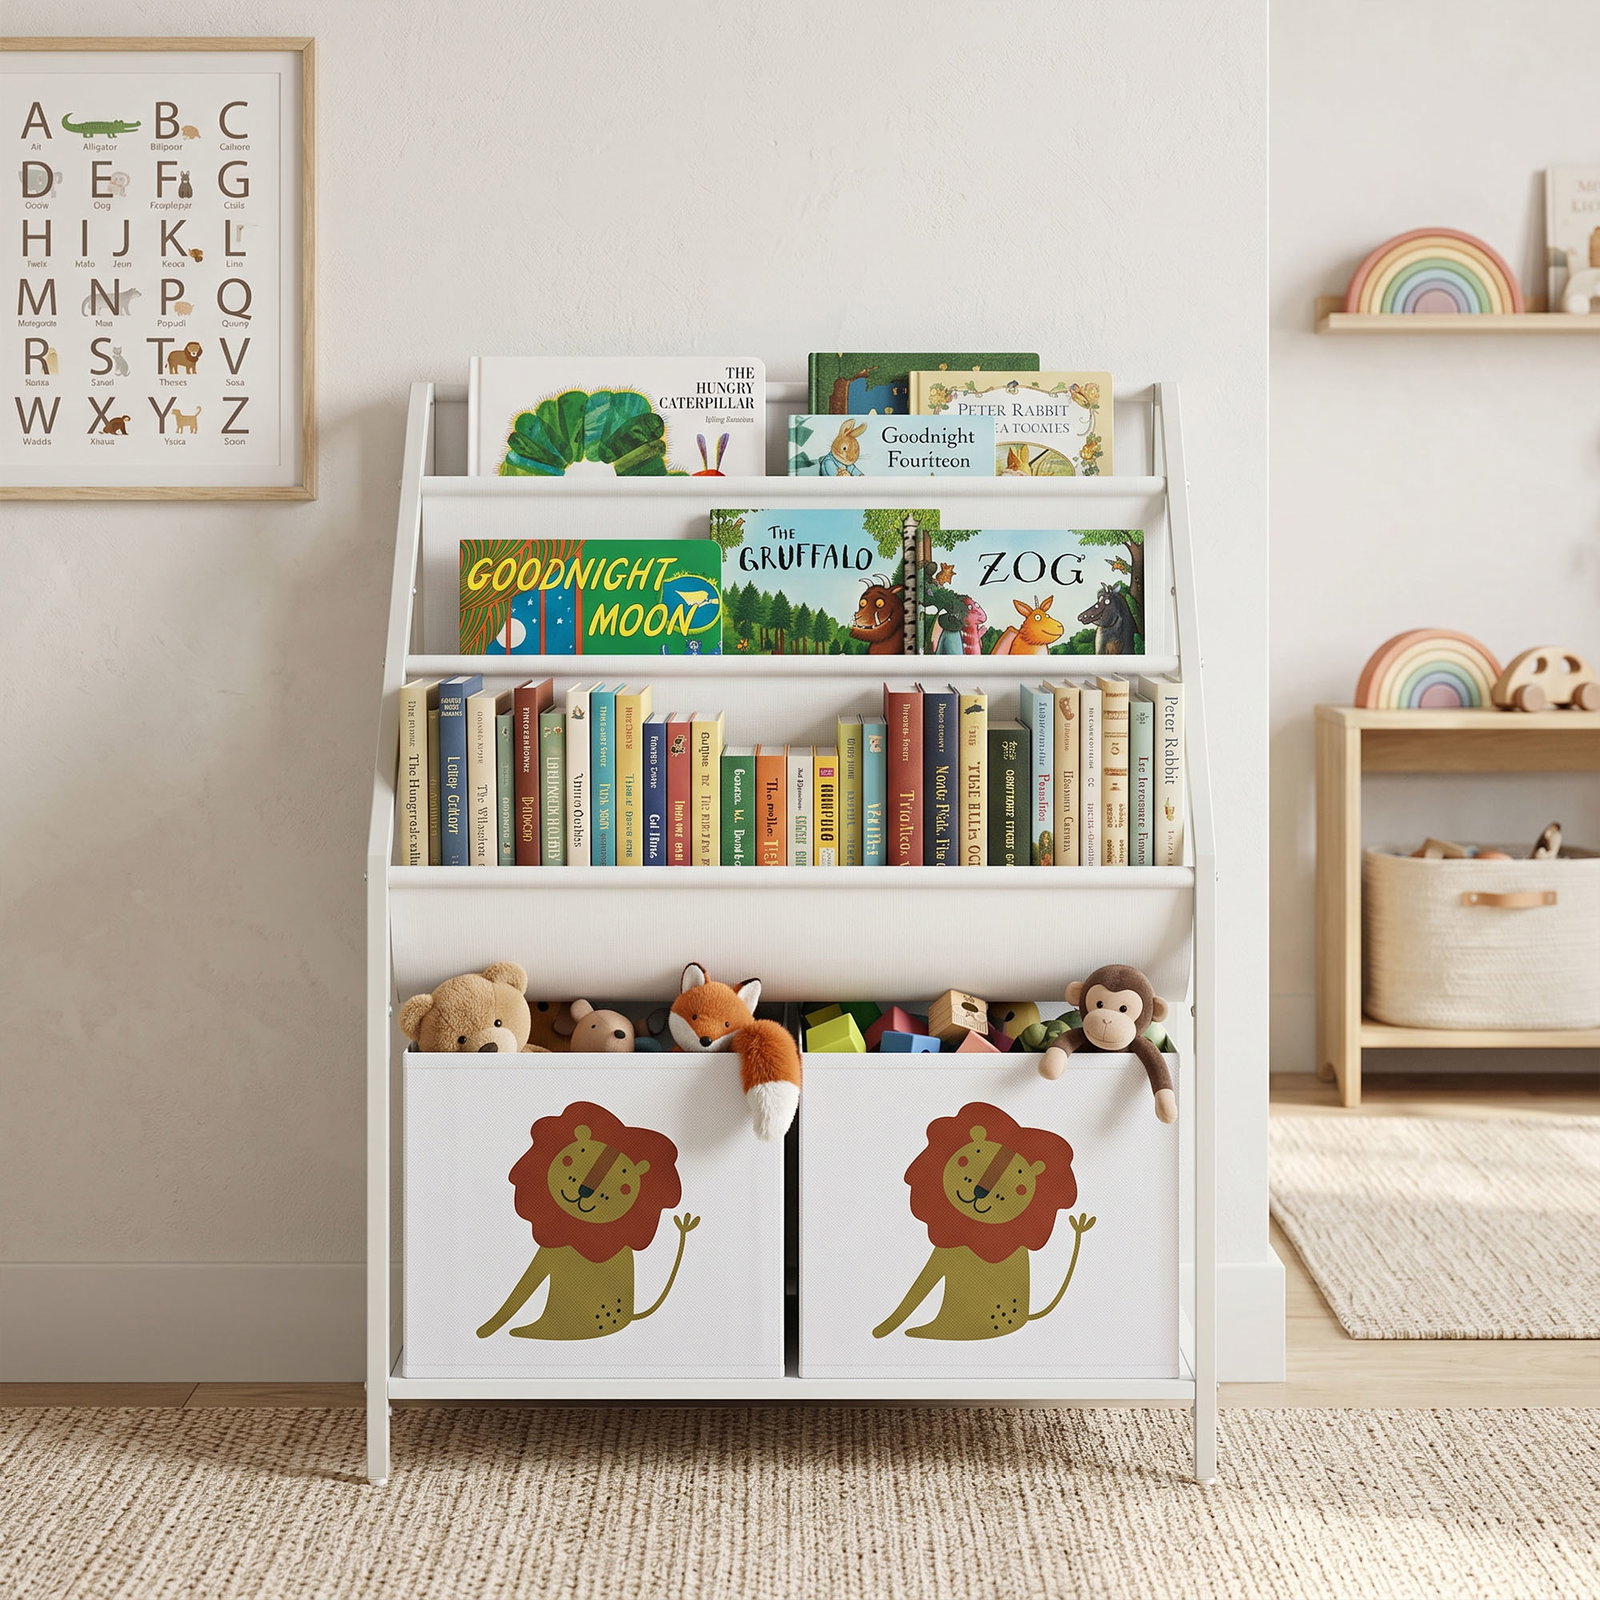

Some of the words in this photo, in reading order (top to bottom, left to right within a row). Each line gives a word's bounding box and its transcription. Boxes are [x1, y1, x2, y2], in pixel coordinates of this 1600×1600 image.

[20, 101, 53, 140] A
[155, 101, 180, 140] B
[219, 101, 249, 140] C
[83, 143, 118, 153] Alligator
[22, 161, 54, 199] D
[91, 161, 114, 199] E
[156, 161, 178, 199] F
[217, 161, 249, 199] G
[22, 219, 51, 257] H
[82, 219, 88, 257] I
[112, 219, 130, 257] J
[160, 219, 188, 257] K
[225, 219, 247, 257] L
[17, 278, 57, 316] M
[90, 278, 120, 316] N
[161, 278, 185, 316] P
[217, 278, 252, 321] Q
[25, 337, 50, 375] R
[90, 337, 113, 376] S
[146, 337, 175, 375] T
[219, 337, 251, 375] V
[725, 366, 755, 379] THE
[659, 397, 755, 409] CATERPILLAR
[696, 382, 755, 394] HUNGRY
[14, 396, 61, 434] W
[87, 396, 116, 434] X
[147, 396, 177, 434] Y
[221, 396, 250, 434] Z
[958, 403, 1006, 417] PETER
[1012, 403, 1070, 417] RABBIT
[881, 426, 975, 449] Goodnight
[767, 525, 796, 540] THE
[467, 557, 678, 591] GOODNIGHT
[739, 543, 874, 572] GRUFFALO
[977, 551, 1086, 587] ZOG
[588, 603, 699, 637] MOON
[1164, 696, 1180, 733] Peter
[1164, 737, 1180, 785] Rabbit
